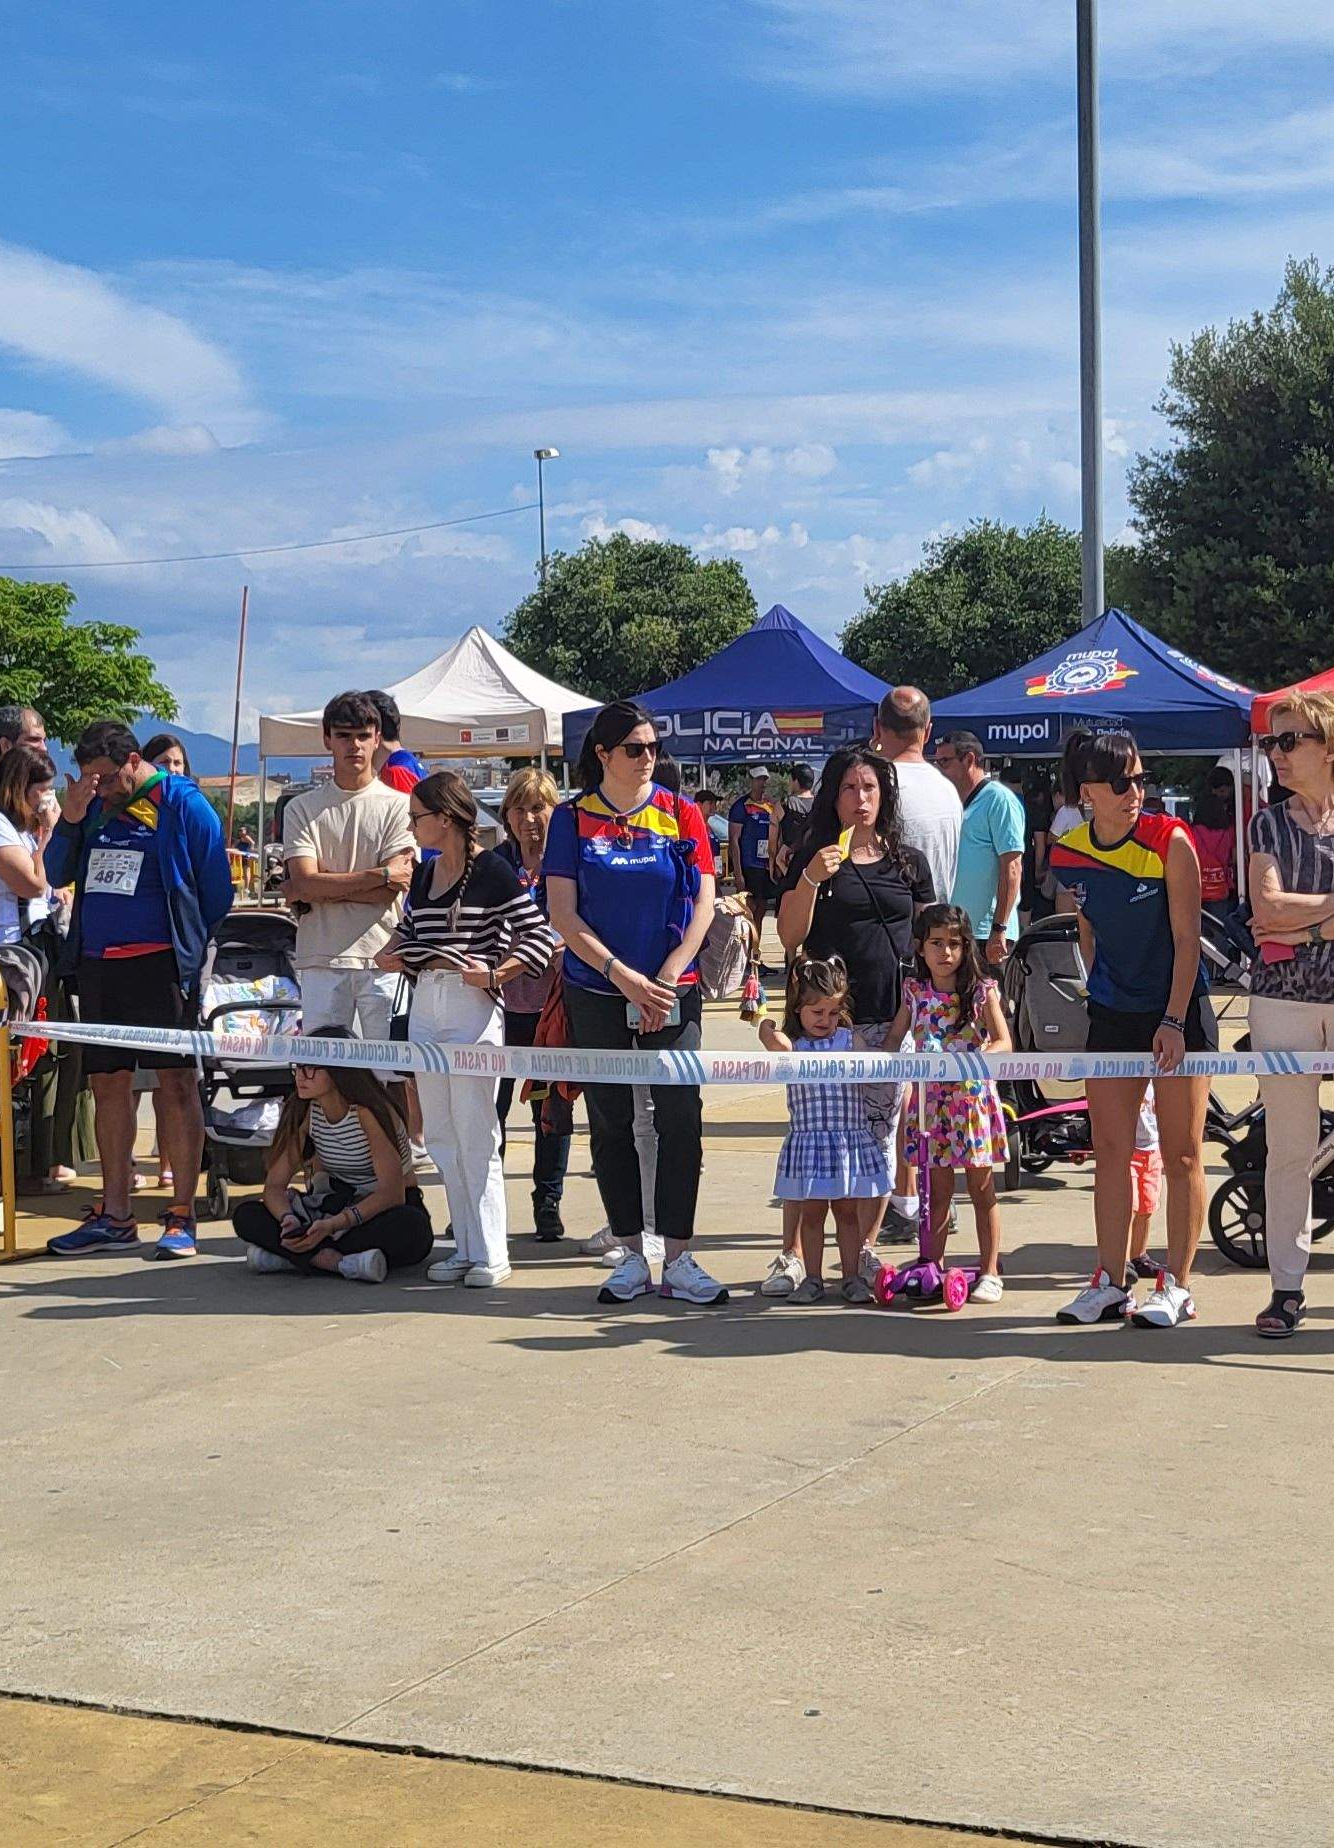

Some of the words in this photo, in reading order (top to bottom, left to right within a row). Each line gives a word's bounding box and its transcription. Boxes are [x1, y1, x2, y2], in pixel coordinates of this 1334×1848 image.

[1066, 648, 1118, 661] mupol
[652, 711, 779, 738] OLICÍA
[1073, 717, 1123, 727] Mutualidad
[988, 719, 1049, 743] mupol
[704, 737, 823, 751] NACIONAL
[630, 855, 657, 864] mupol
[94, 870, 126, 884] 487
